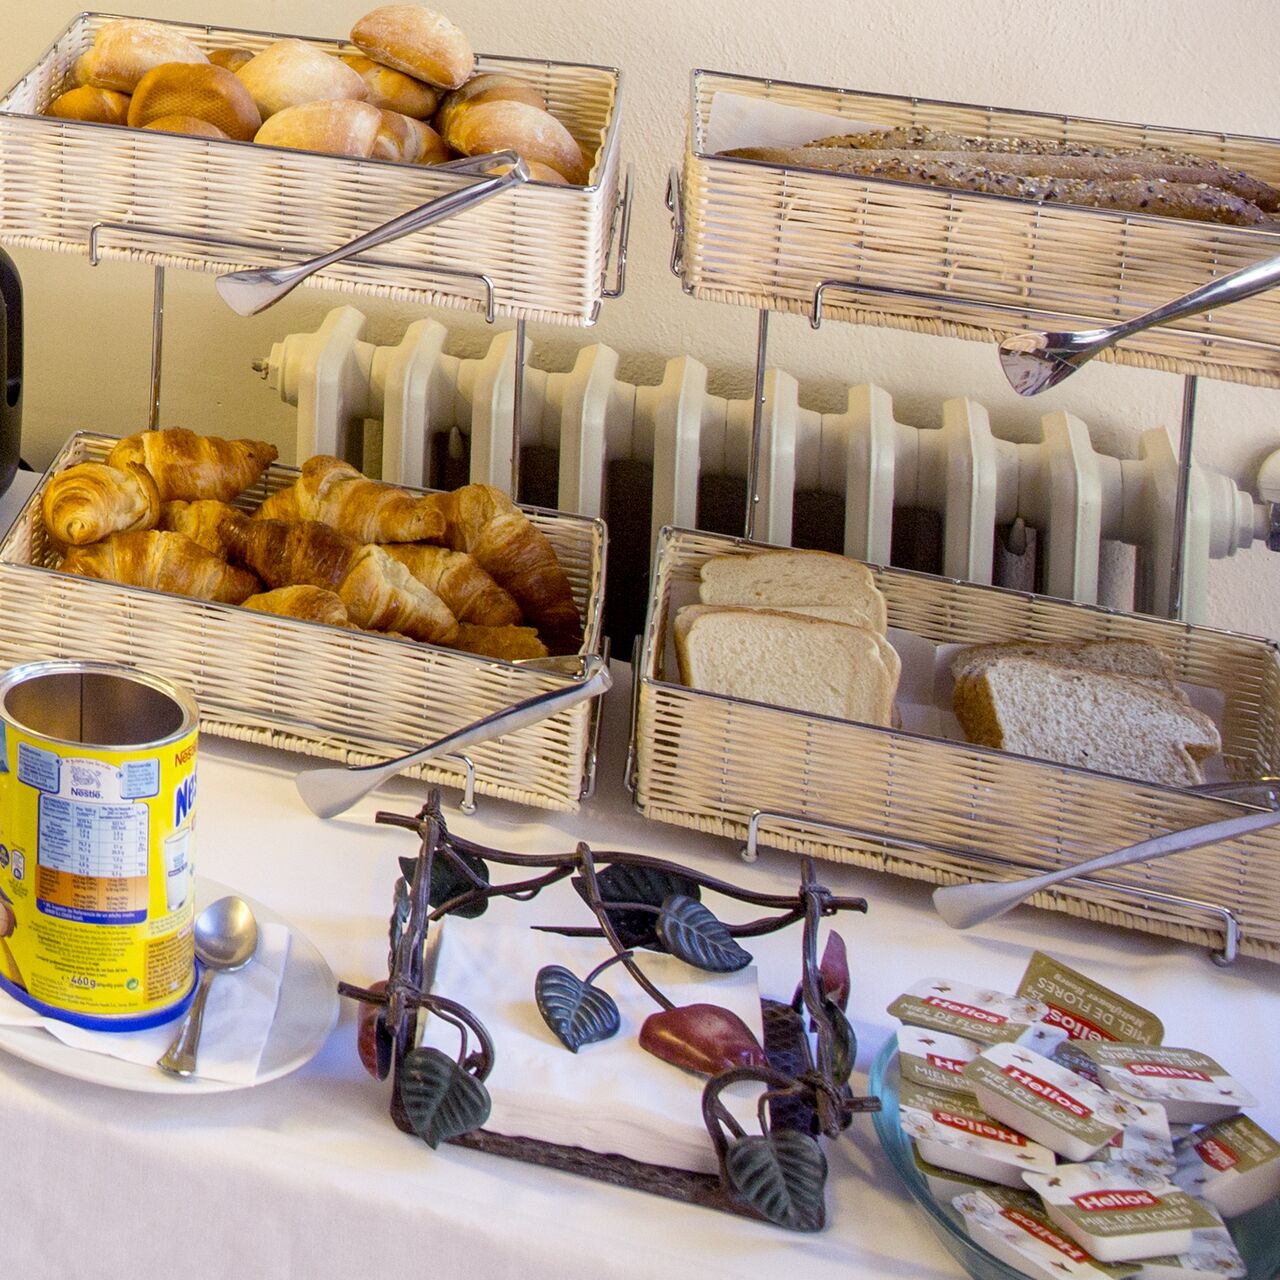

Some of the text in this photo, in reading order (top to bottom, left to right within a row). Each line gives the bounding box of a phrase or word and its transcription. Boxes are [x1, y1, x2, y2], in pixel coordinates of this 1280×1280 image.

[900, 1002, 931, 1016] MIEL
[955, 1017, 1010, 1036] FLORES
[929, 998, 999, 1023] Helios
[1036, 976, 1153, 1045] MIEL DE FLORES
[1048, 1008, 1110, 1043] elios
[1130, 1064, 1205, 1081] Helios
[975, 1066, 1010, 1088] MIEL
[1036, 1100, 1095, 1133] FLORES
[1009, 1069, 1085, 1116] Helios
[938, 1111, 1019, 1144] Helios
[1078, 1192, 1154, 1209] Helios
[1136, 1206, 1194, 1222] FLORES
[1009, 1211, 1084, 1259] Helios
